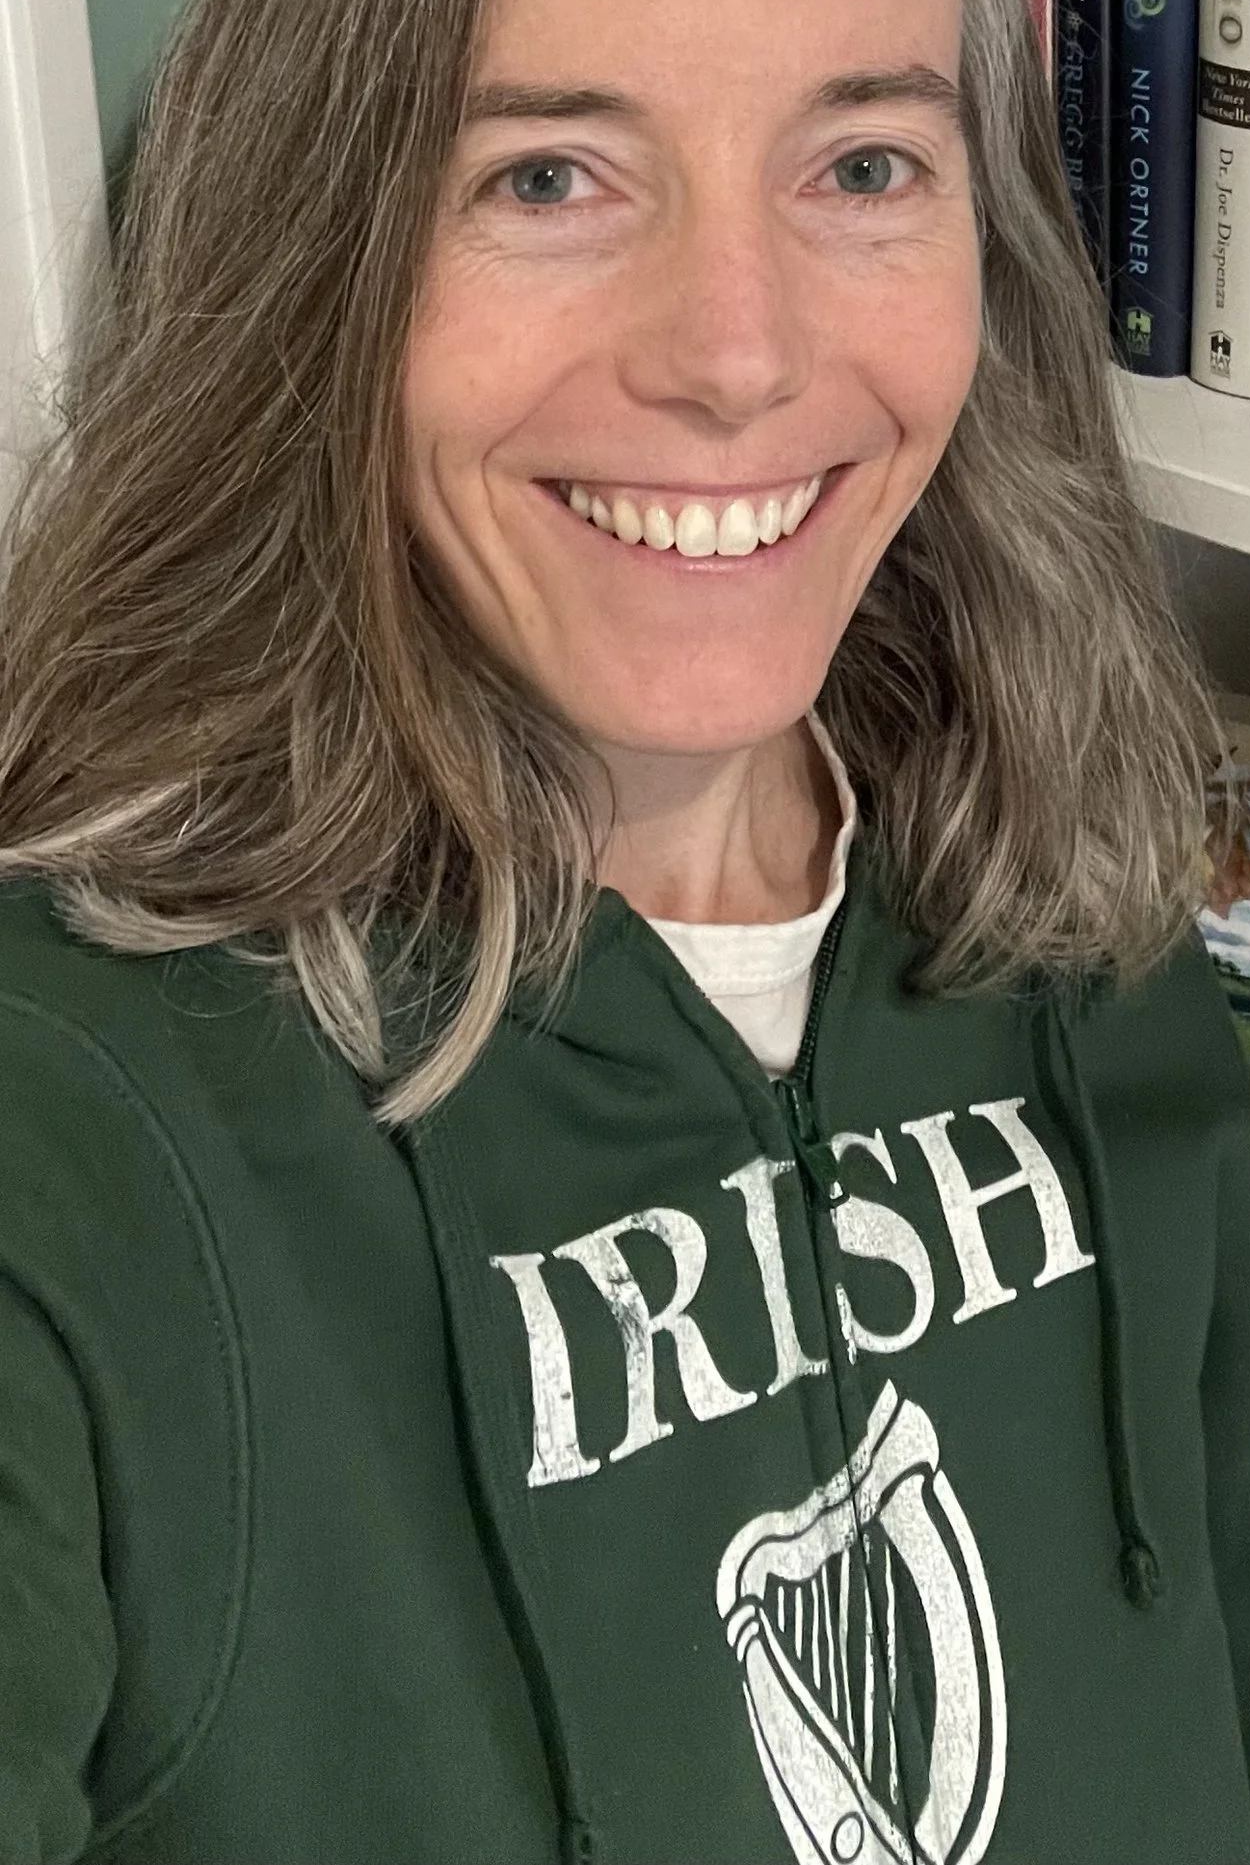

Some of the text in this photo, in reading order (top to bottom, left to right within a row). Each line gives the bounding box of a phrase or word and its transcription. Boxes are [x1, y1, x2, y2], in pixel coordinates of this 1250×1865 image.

[1129, 68, 1150, 275] NICK ORTNER
[1211, 86, 1245, 106] Times
[1213, 148, 1234, 309] Dr. Joe Dispenza
[489, 1097, 1095, 1488] IRISH
